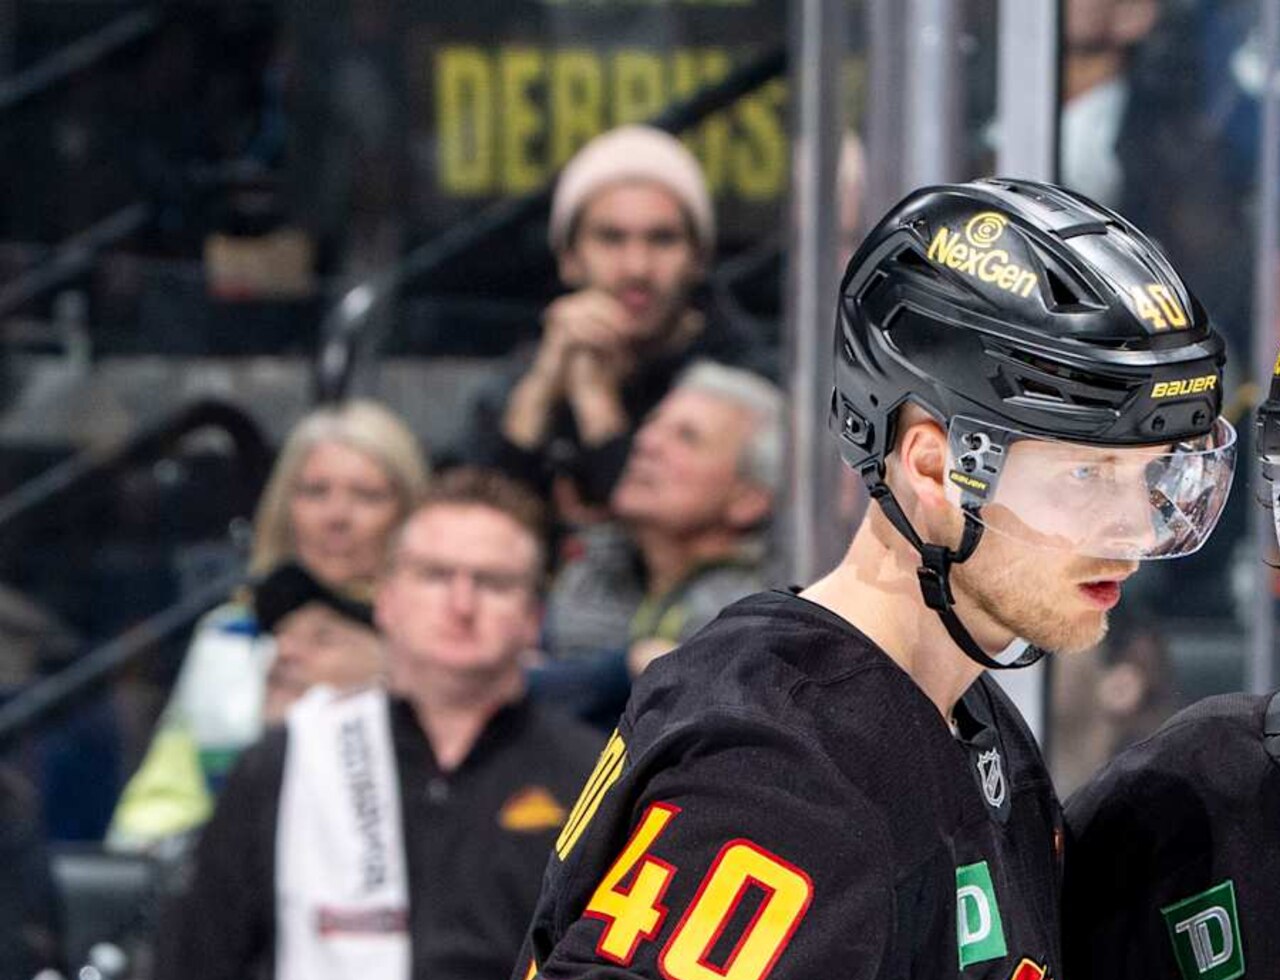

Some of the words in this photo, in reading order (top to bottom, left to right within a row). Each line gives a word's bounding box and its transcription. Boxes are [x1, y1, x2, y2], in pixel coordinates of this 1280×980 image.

[928, 227, 1038, 298] NexGen
[1133, 284, 1188, 330] 40
[1151, 374, 1217, 398] BAUER
[1175, 905, 1234, 973] TD
